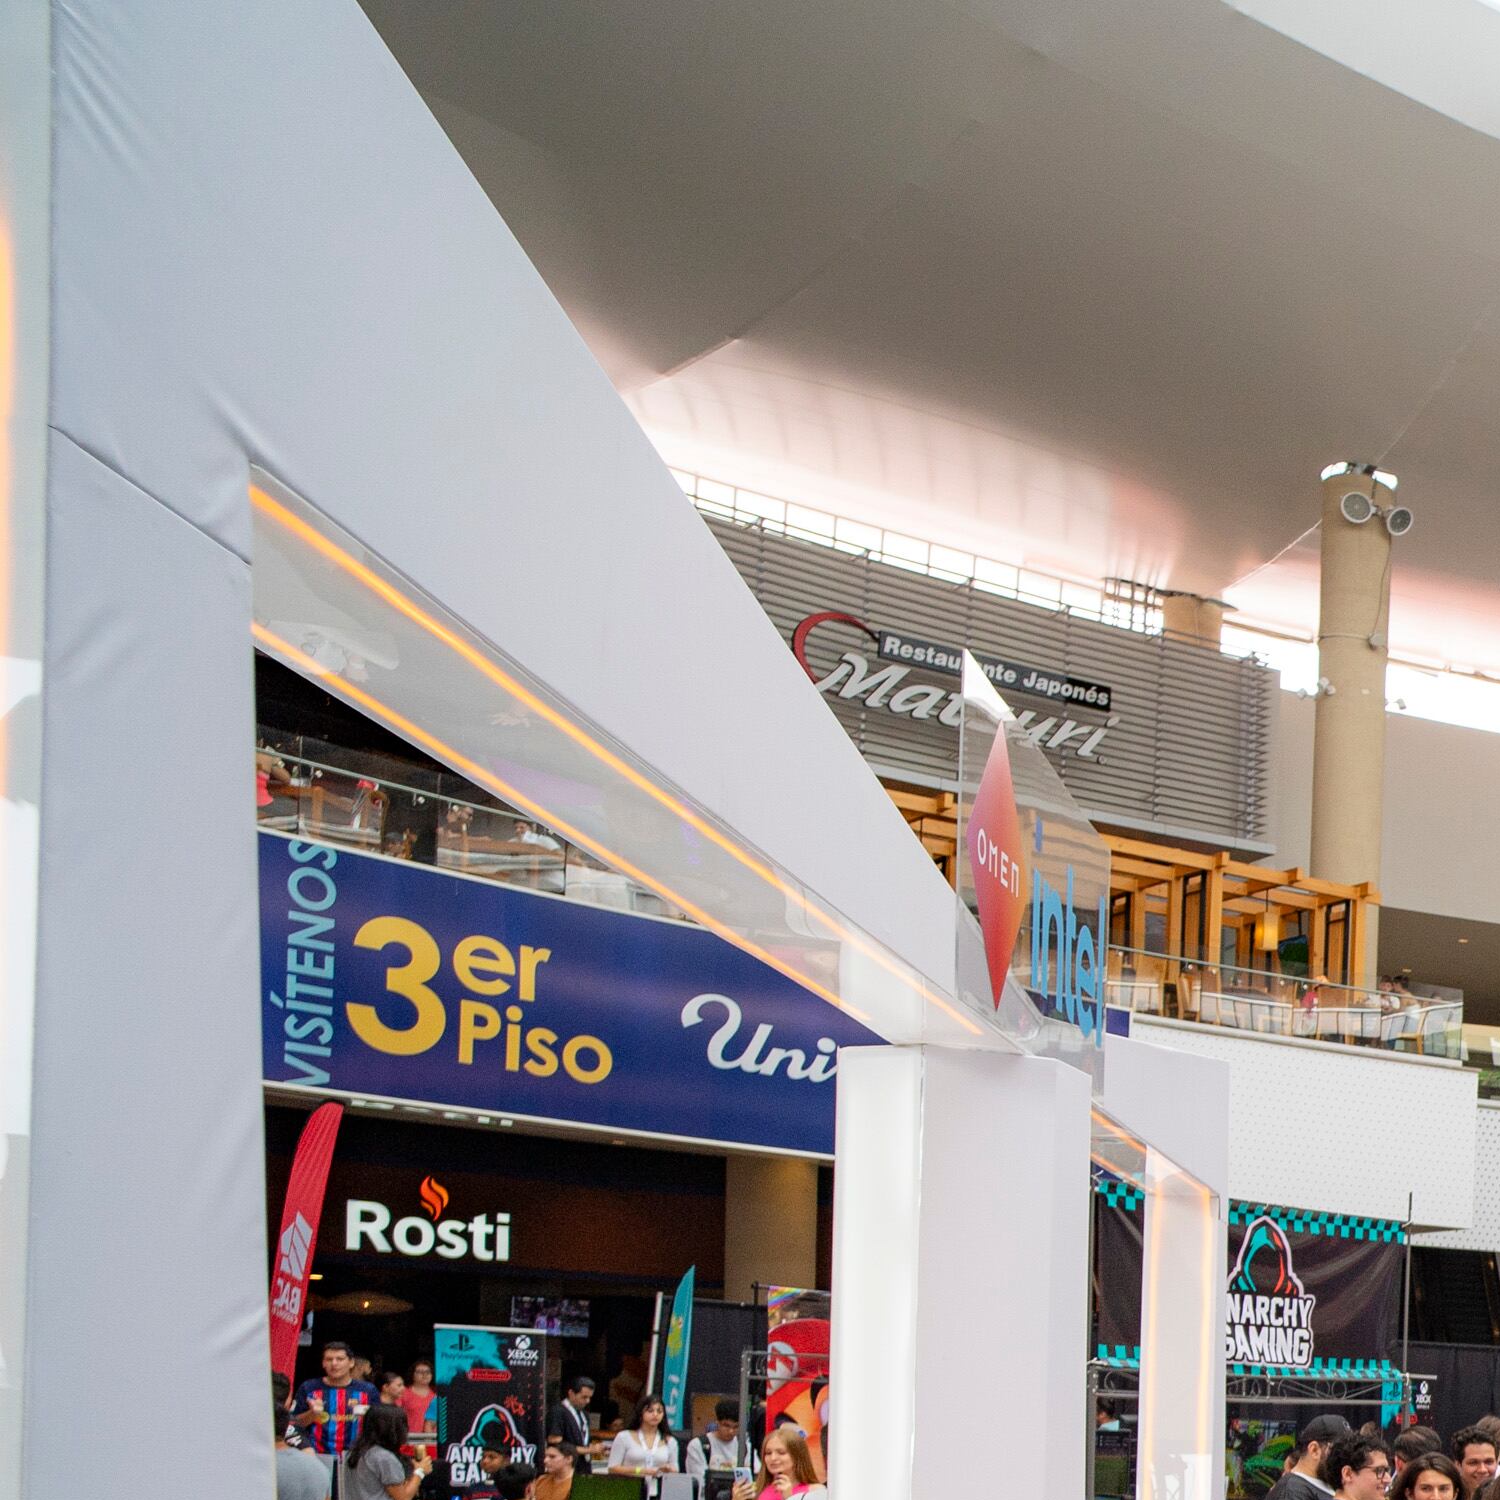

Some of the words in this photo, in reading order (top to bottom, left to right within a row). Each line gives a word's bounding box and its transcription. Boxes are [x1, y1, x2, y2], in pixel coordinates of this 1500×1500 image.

[816, 653, 1120, 757] Maturi
[883, 635, 1017, 684] Restaunte
[1022, 671, 1110, 706] Japonés
[978, 828, 1019, 898] OMEN
[270, 839, 338, 1085] VISÍTENOS
[1031, 816, 1106, 1048] intel
[458, 999, 613, 1084] Piso
[346, 1199, 510, 1262] Rosti
[1226, 1293, 1313, 1328] NARCHY
[507, 1349, 539, 1360] XBOX
